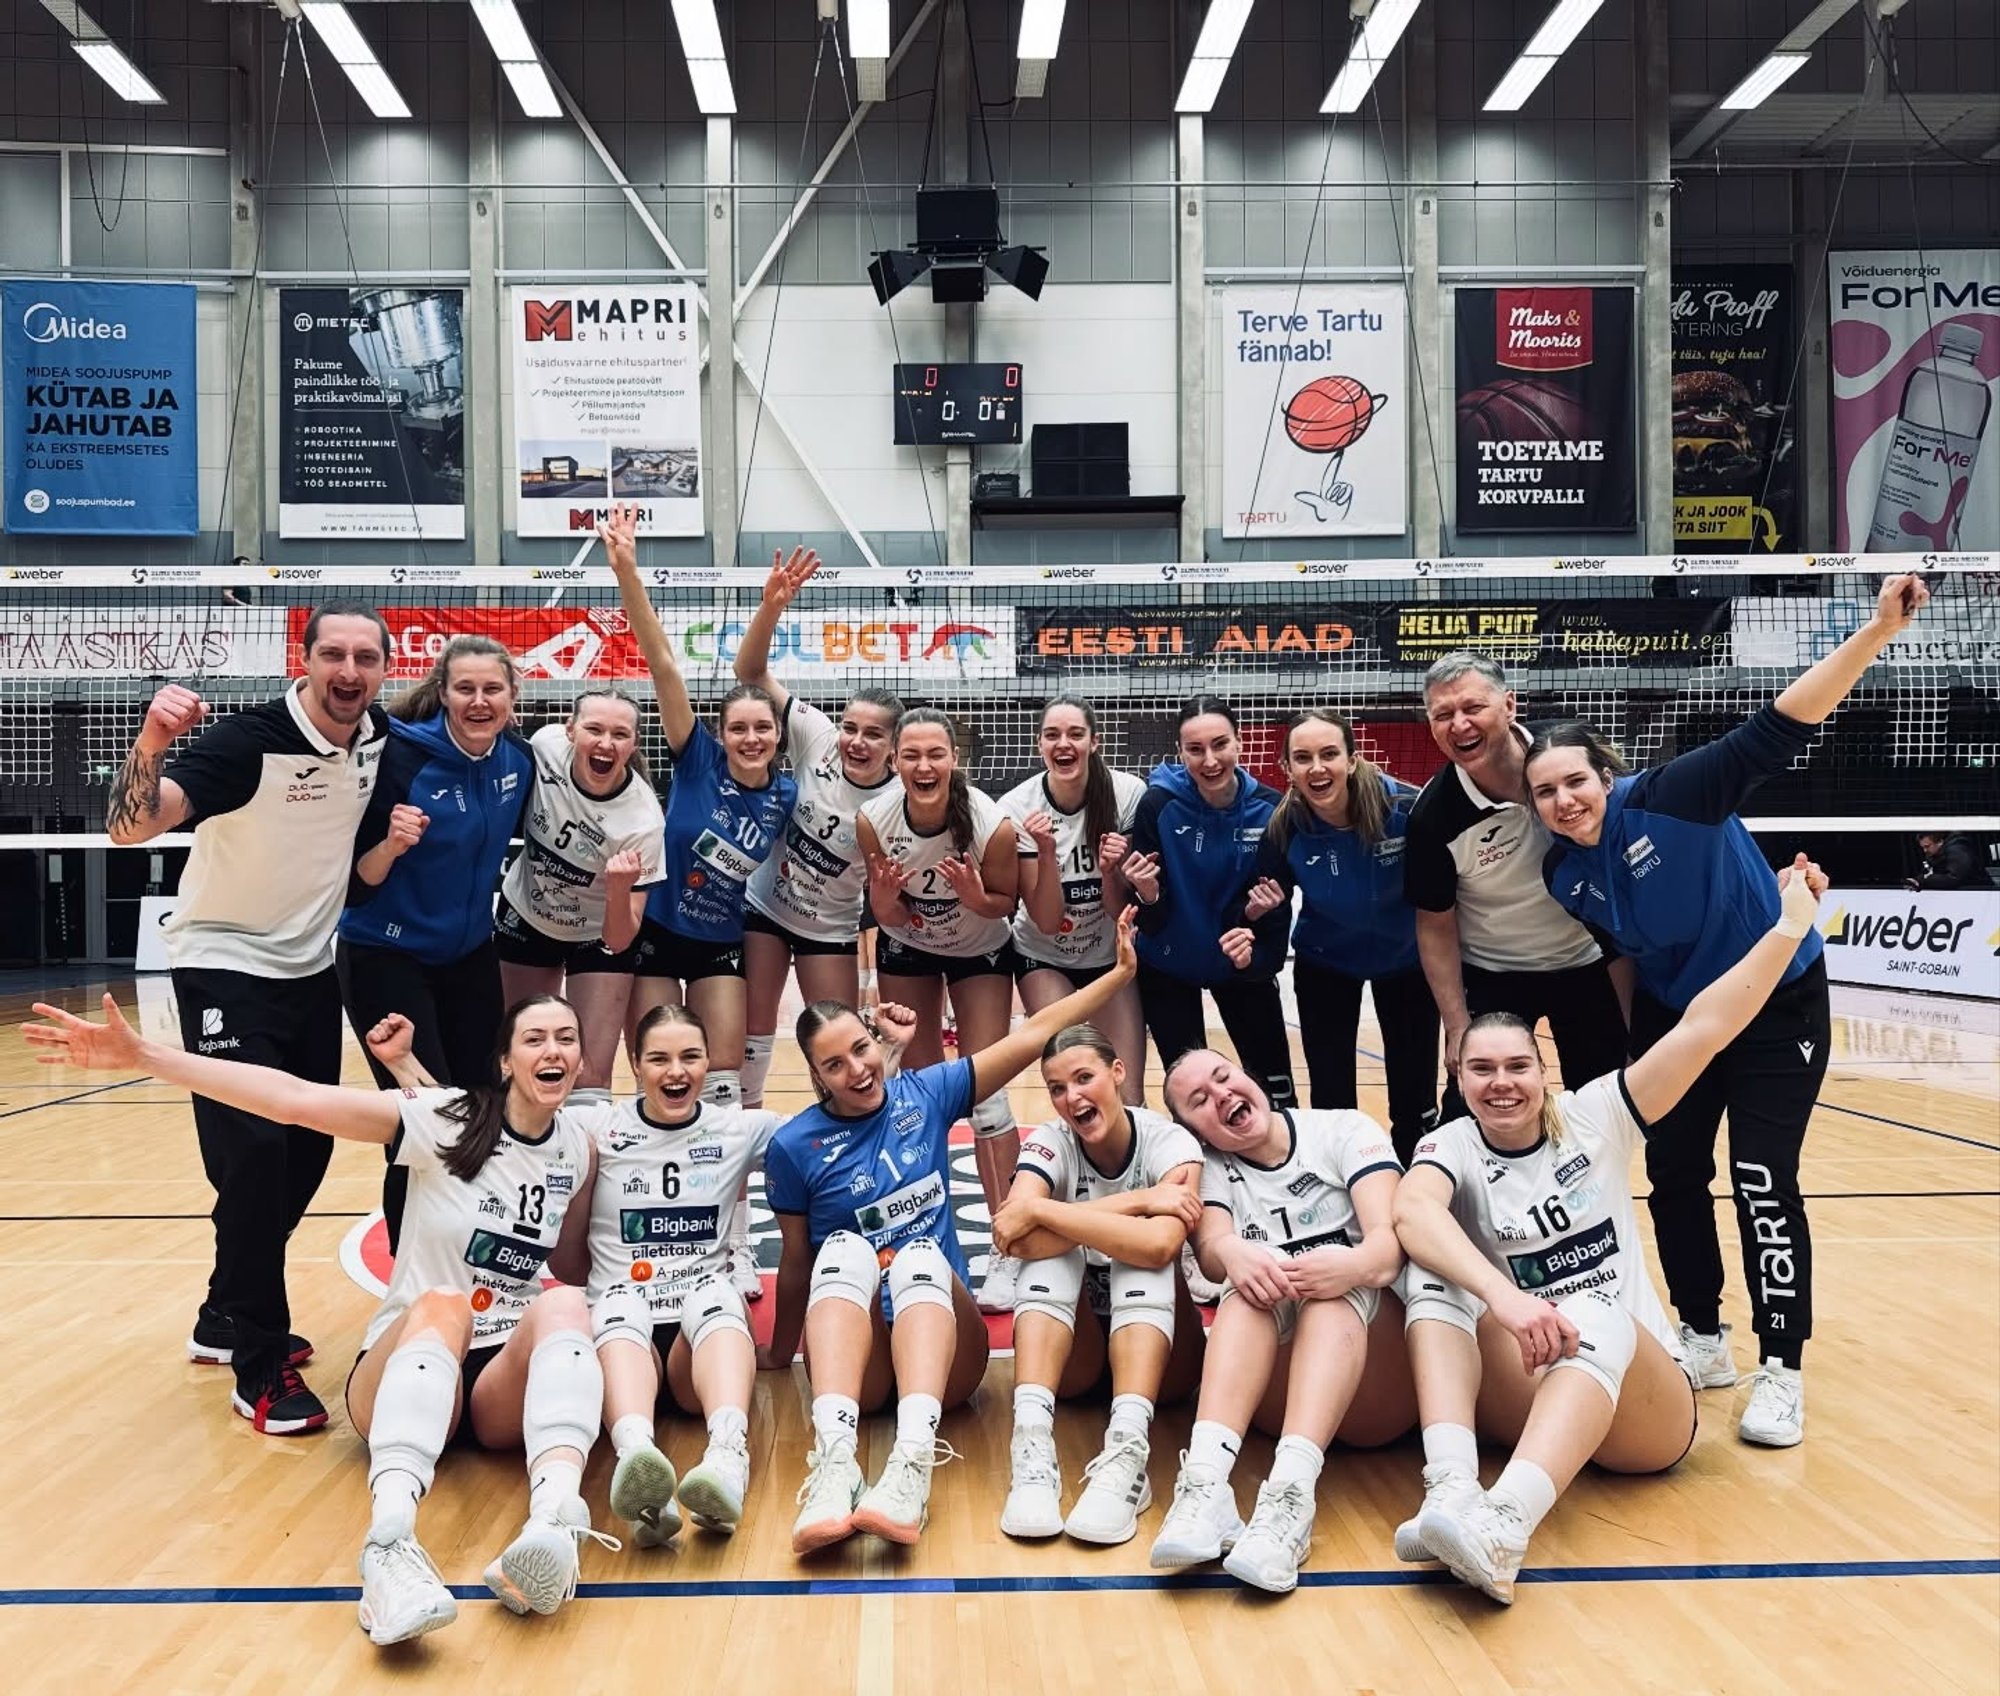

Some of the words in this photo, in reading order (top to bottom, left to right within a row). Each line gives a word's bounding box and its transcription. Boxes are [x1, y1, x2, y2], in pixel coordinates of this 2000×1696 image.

[1842, 265, 1941, 278] Võiduenergia
[1842, 283, 1924, 309] For
[577, 299, 686, 324] MAPRI
[1509, 307, 1561, 327] Maks
[1564, 309, 1581, 326] &
[1704, 290, 1779, 329] Proff
[38, 316, 127, 340] Midea
[1237, 310, 1308, 333] Terve
[1317, 309, 1382, 332] Tartu
[577, 327, 687, 342] ehitus
[1509, 329, 1582, 348] Moorits
[1237, 339, 1332, 362] fännab!
[26, 367, 70, 378] MIDEA
[75, 367, 173, 380] SOOJUSPUMP
[294, 359, 343, 371] Pakume
[294, 376, 358, 389] paindlikke
[925, 367, 938, 387] 0
[1005, 366, 1018, 387] 0
[26, 381, 131, 408] KÜTAB
[140, 388, 179, 410] JA
[942, 401, 955, 421] 0
[978, 401, 992, 421] 0
[26, 413, 172, 437] JAHUTAB
[26, 443, 45, 453] KA
[51, 443, 169, 456] EKSTREEMSETES
[304, 440, 397, 448] PROJEKTEERIMINE
[1478, 441, 1604, 461] TOETAME
[26, 459, 84, 470] OLUDES
[1478, 468, 1542, 483] TARTU
[1478, 489, 1585, 505] KORVPALLI
[1687, 506, 1706, 518] JA
[1708, 505, 1747, 518] JOOK
[1698, 522, 1727, 533] SIIT
[1308, 563, 1349, 574] isover
[1562, 559, 1606, 570] weber
[1817, 556, 1857, 567] isover
[20, 568, 64, 580] weber
[282, 569, 322, 579] isover
[541, 568, 587, 580] weber
[1052, 567, 1096, 579] weber
[1399, 615, 1469, 636] HELIA
[1479, 613, 1539, 635] PUIT
[1562, 615, 1607, 627] www.
[1038, 627, 1184, 655] EESTI
[1213, 623, 1353, 653] AIAD
[1562, 629, 1723, 656] heliapuit.ee
[555, 820, 578, 850] 5
[735, 816, 760, 850] 10
[818, 815, 840, 840] 3
[798, 838, 843, 875] Bigbank
[1071, 845, 1095, 874] 15
[922, 869, 936, 894] 2
[385, 923, 402, 939] EH
[1852, 905, 1973, 952] weber
[1887, 960, 1960, 977] SAINT-GOBAIN
[199, 1036, 241, 1054] Bigbank
[879, 1149, 902, 1182] 1
[1557, 1154, 1590, 1183] SALVEST
[623, 1183, 649, 1195] TARTU
[662, 1161, 680, 1199] 6
[479, 1200, 506, 1219] TARTU
[519, 1184, 545, 1224] 13
[887, 1182, 942, 1219] Bigbank
[1270, 1207, 1293, 1240] 7
[1527, 1194, 1571, 1239] 16
[651, 1216, 714, 1238] Bigbank
[632, 1243, 707, 1261] piletitasku
[1546, 1231, 1615, 1273] Bigbank
[1771, 1313, 1785, 1329] 21
